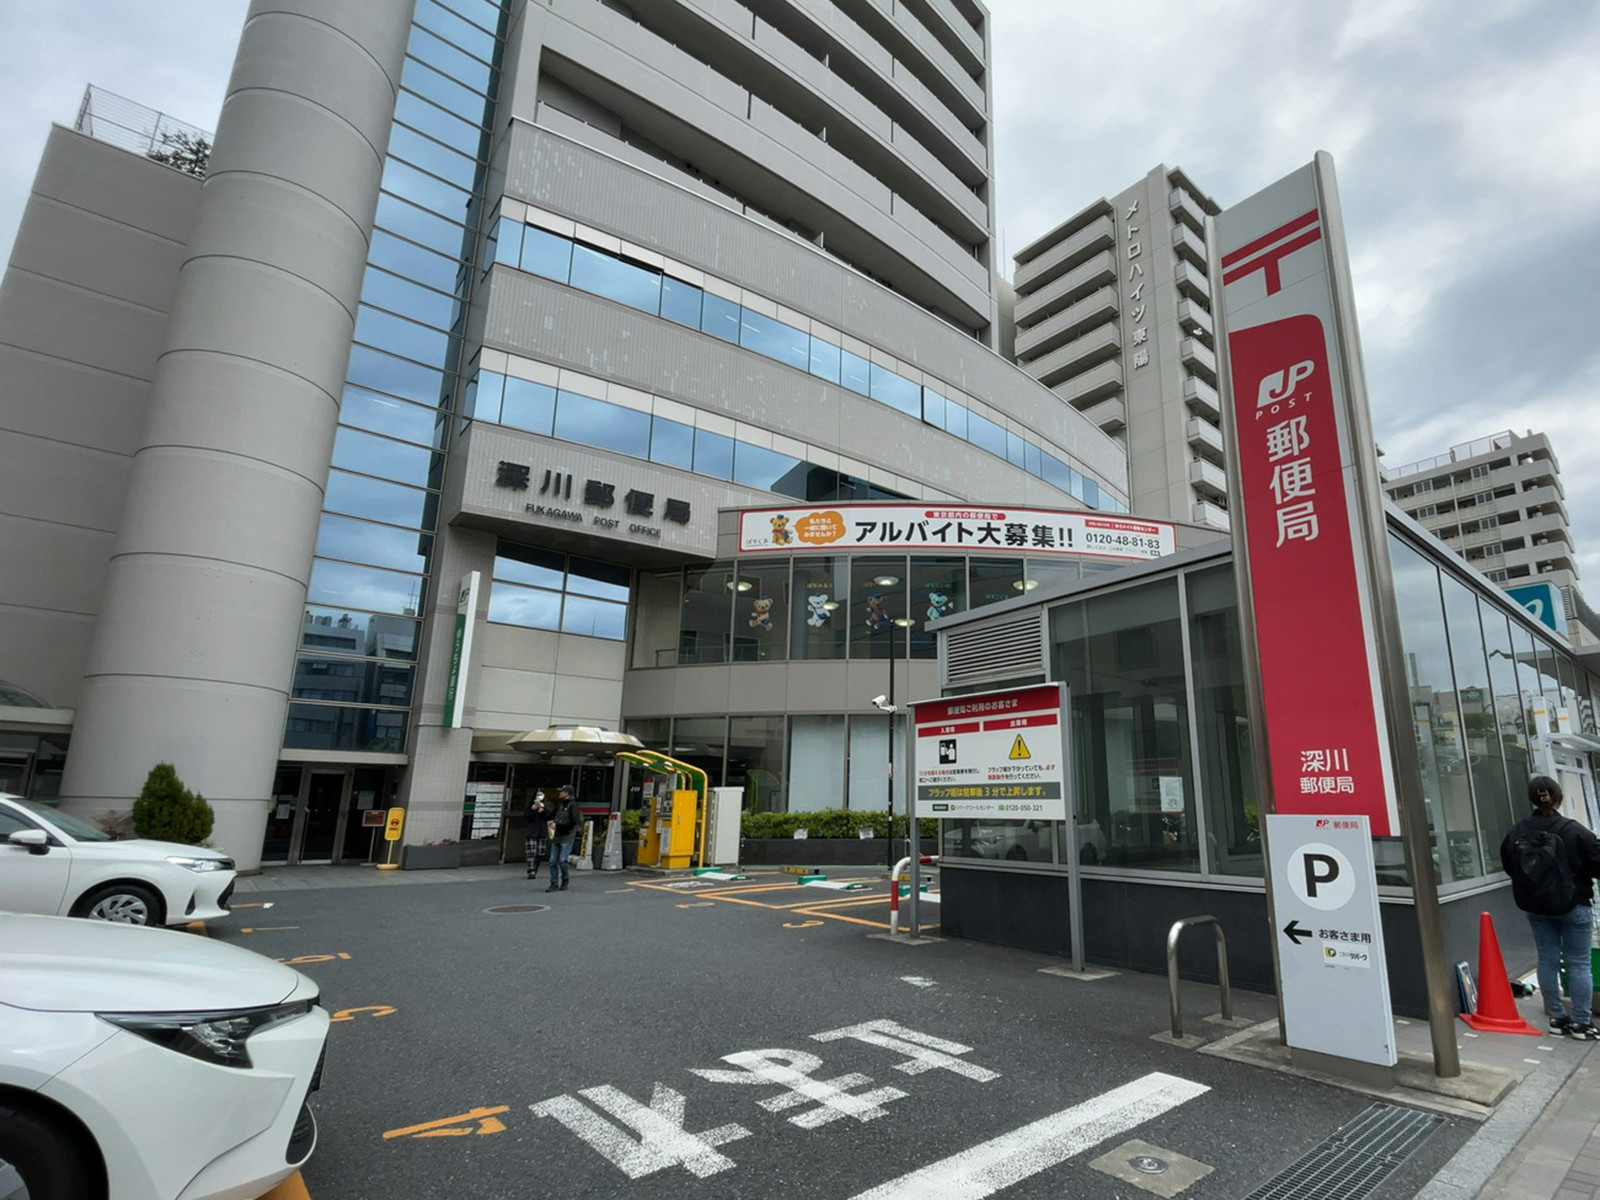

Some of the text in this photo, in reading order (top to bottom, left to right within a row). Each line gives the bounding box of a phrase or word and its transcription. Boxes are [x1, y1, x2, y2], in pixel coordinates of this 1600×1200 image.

[1125, 200, 1149, 369] メトロハイツ東陽
[1255, 392, 1313, 420] POST
[495, 460, 691, 526] 深川郵便局
[1266, 414, 1319, 548] 郵便局
[525, 503, 662, 538] FUKAGAWA POST OFFICE
[1085, 533, 1160, 549] 0120-48-81-83
[1300, 748, 1350, 772] 深川
[1300, 776, 1355, 795] 郵便局
[1005, 804, 1043, 812] 0120-050-321
[1333, 821, 1359, 830] 郵便局
[1303, 853, 1340, 898] P
[1318, 928, 1372, 944] お客さま用
